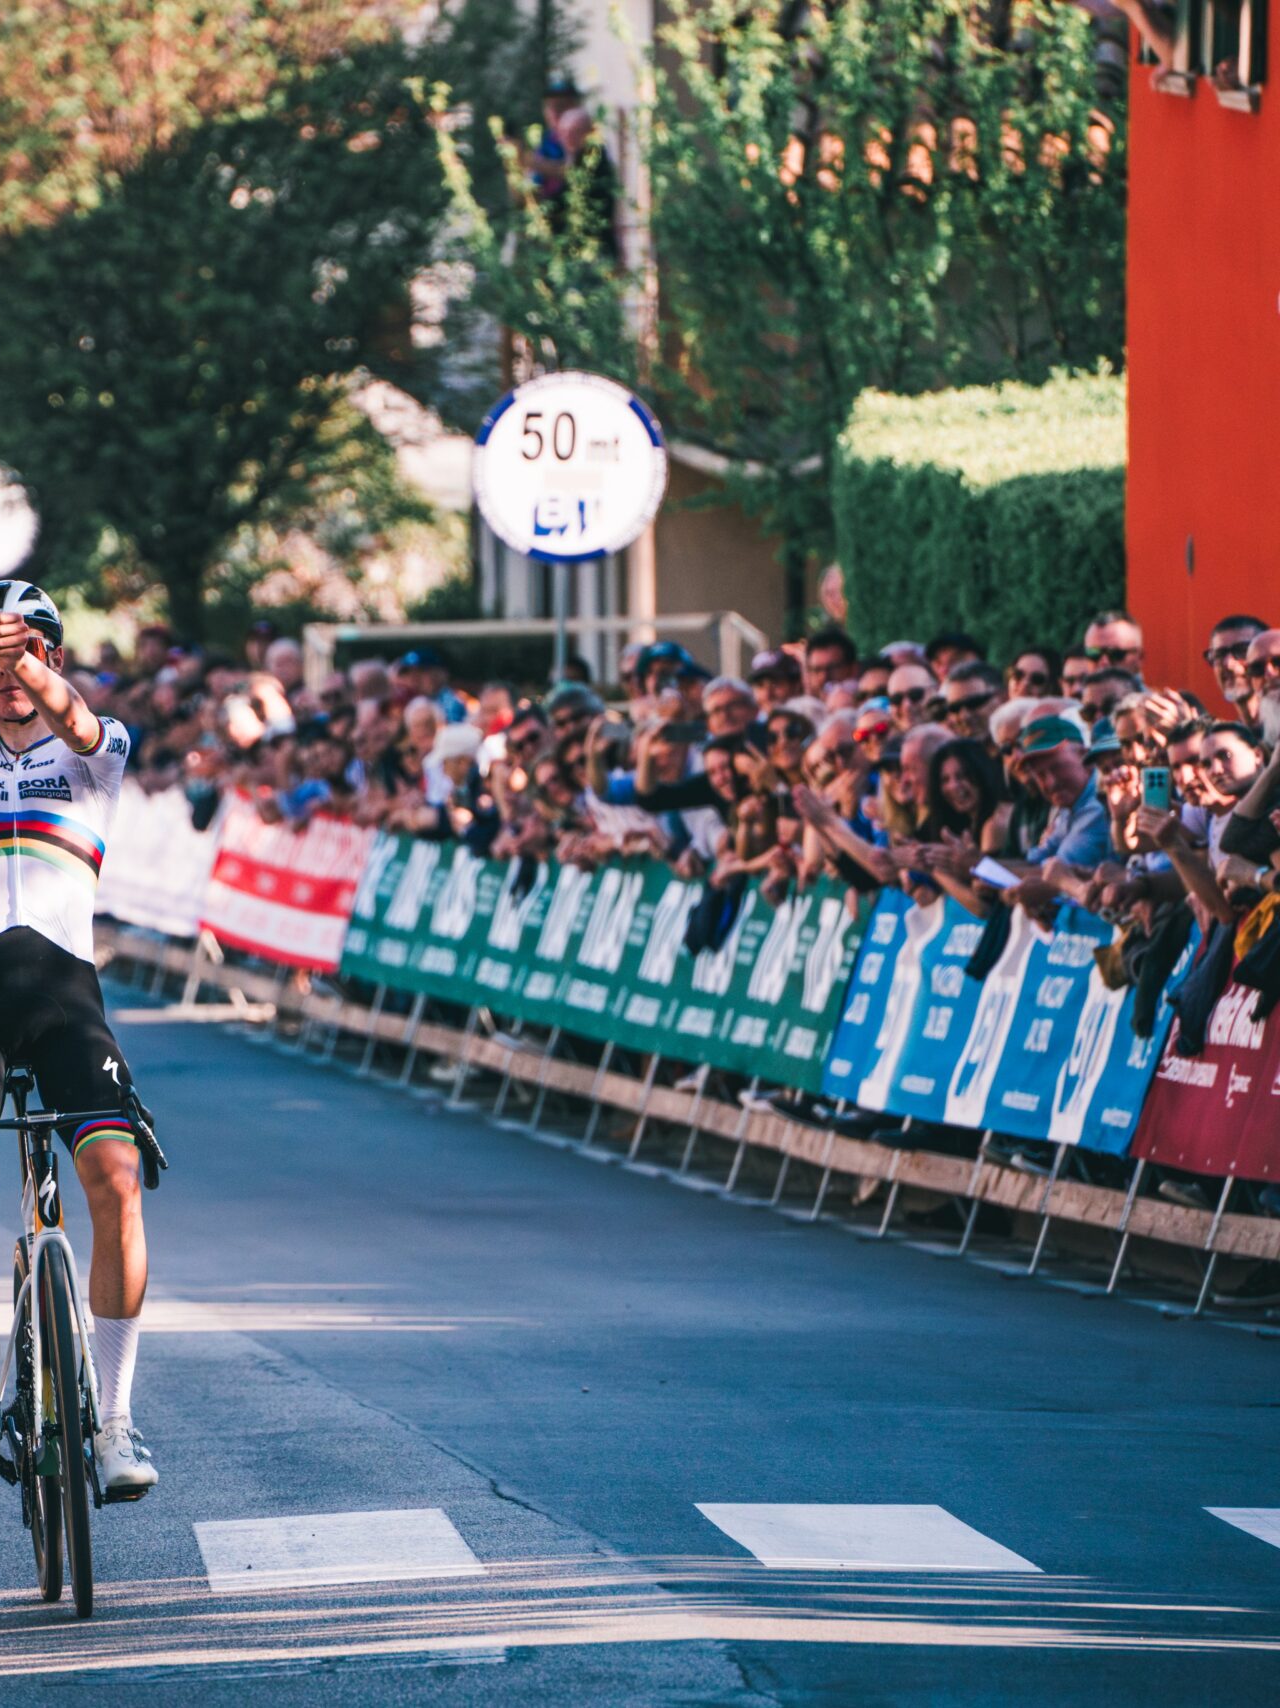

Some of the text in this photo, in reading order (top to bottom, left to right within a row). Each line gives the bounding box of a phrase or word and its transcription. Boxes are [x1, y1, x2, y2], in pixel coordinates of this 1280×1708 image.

[521, 411, 577, 461] 50
[18, 775, 70, 790] BORA
[21, 788, 71, 800] hansgrohe
